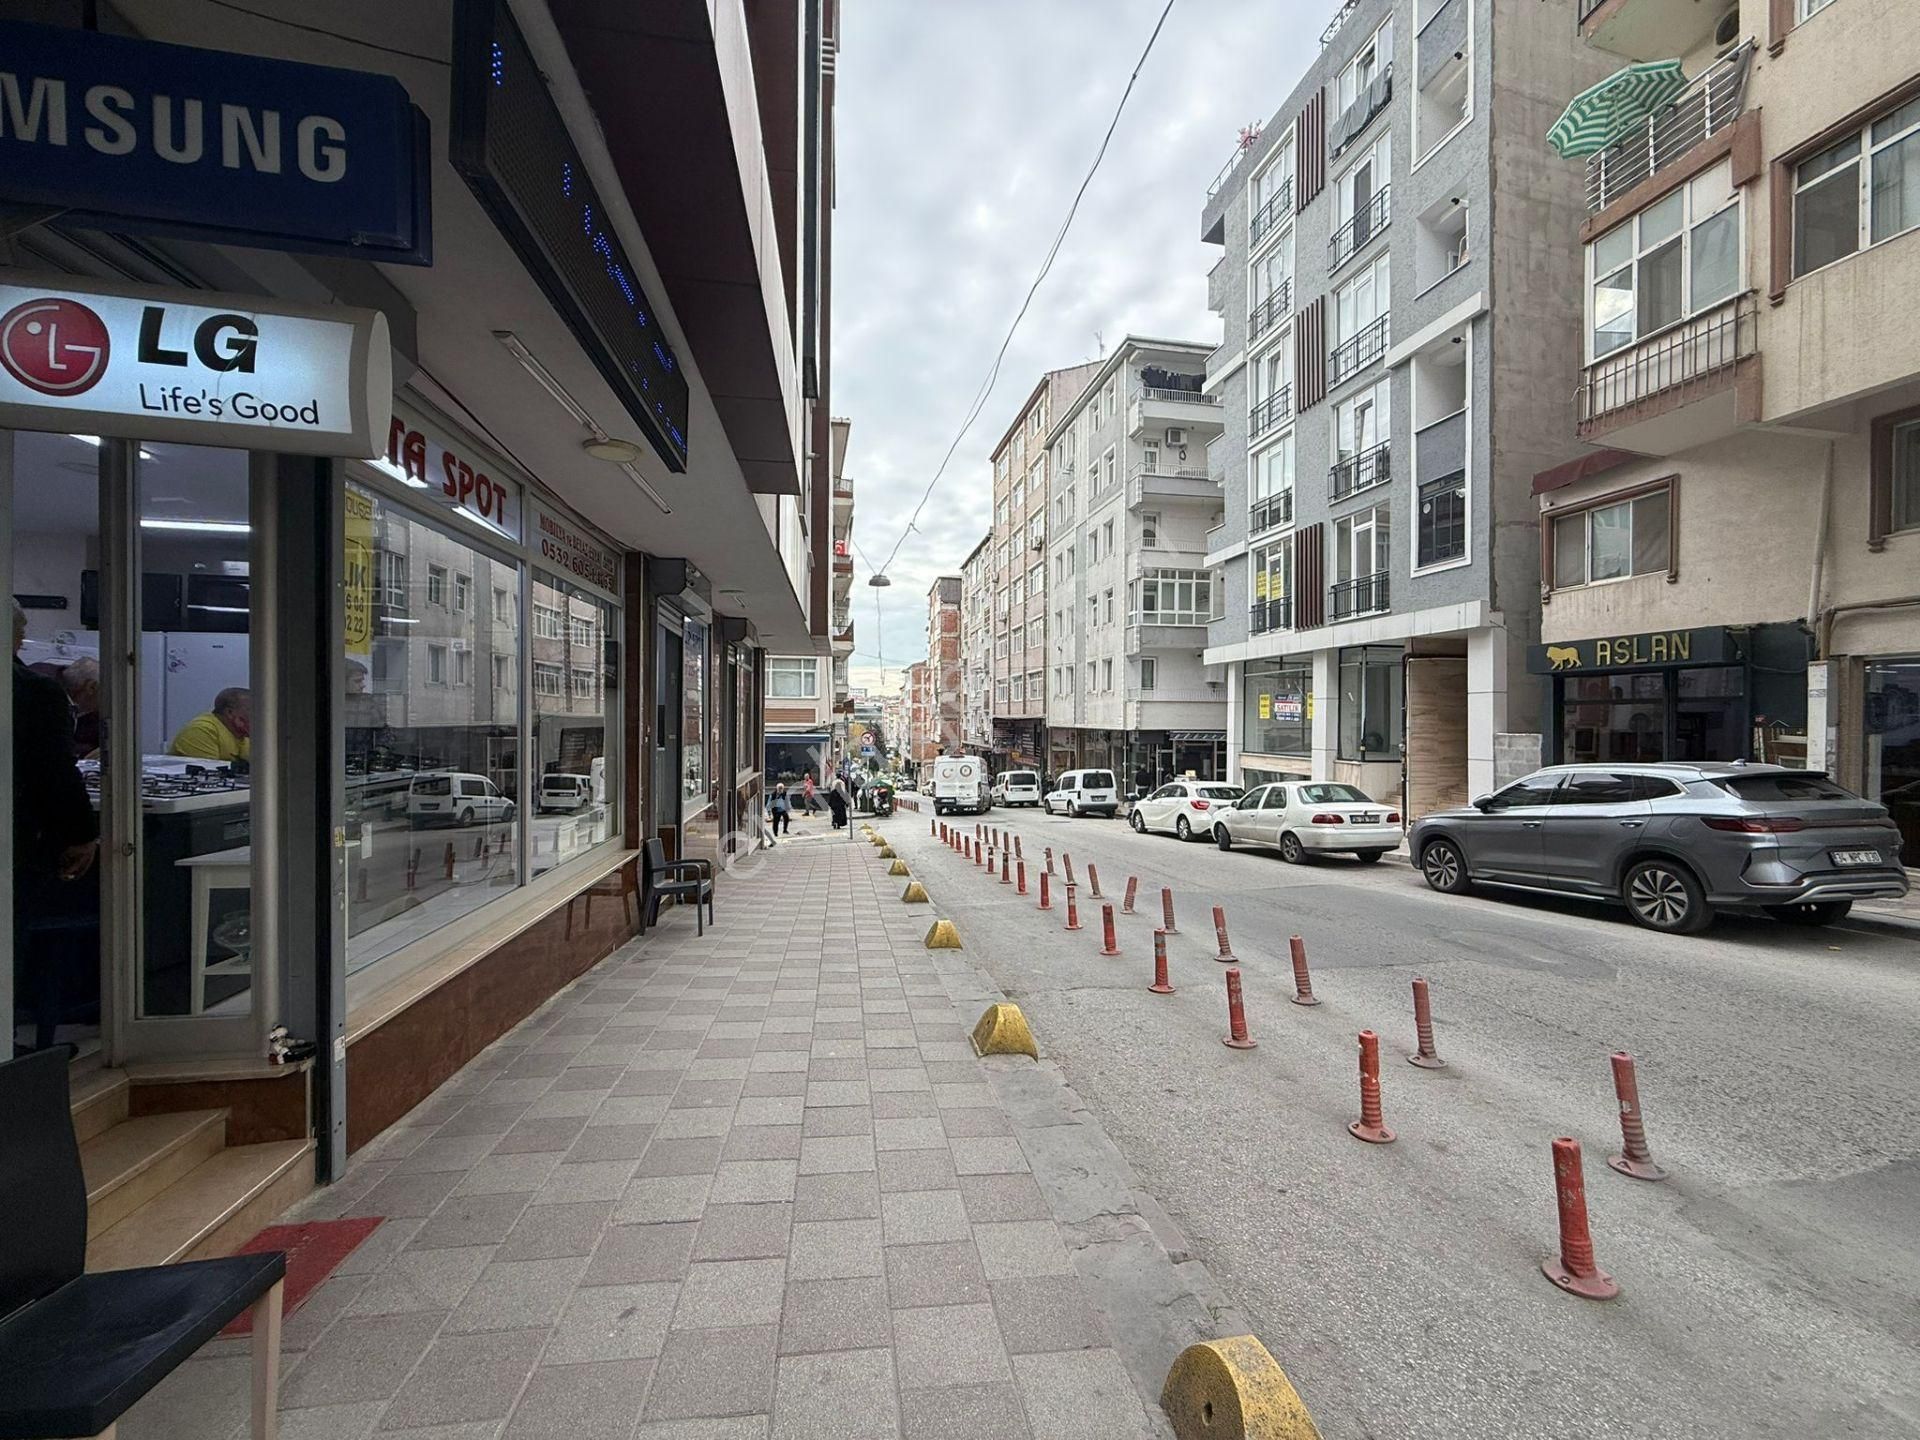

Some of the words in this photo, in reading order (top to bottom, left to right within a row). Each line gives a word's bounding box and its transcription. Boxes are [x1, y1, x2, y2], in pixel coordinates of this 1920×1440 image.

[0, 71, 347, 183] MSUNG
[138, 306, 259, 373] LG
[139, 383, 223, 416] Life's
[231, 392, 320, 425] Good
[442, 451, 507, 526] SPOT
[541, 538, 569, 568] 0532
[344, 561, 366, 592] IK
[1596, 632, 1690, 667] ASLAN
